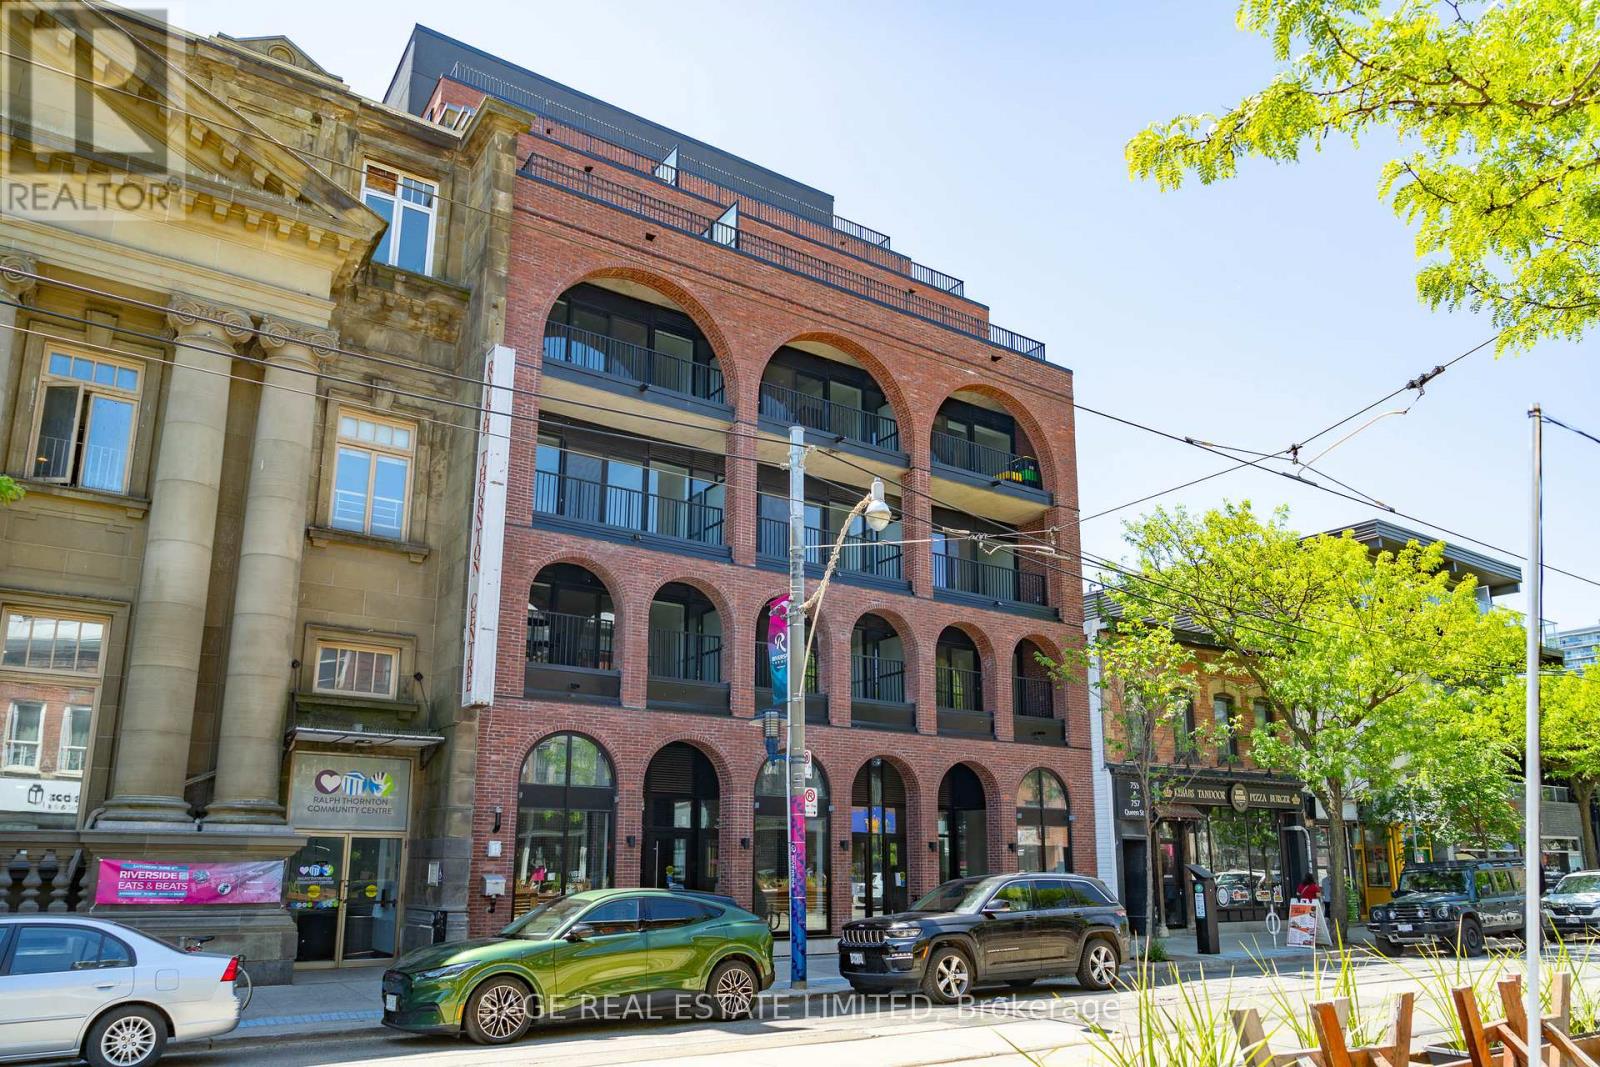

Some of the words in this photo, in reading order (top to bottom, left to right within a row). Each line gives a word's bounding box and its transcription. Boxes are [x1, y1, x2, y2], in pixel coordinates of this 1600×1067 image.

[473, 450, 488, 577] THORNTON
[466, 593, 478, 692] CENTRE
[1197, 789, 1226, 800] TANDOOR
[1249, 793, 1267, 802] PIZZA
[1269, 794, 1291, 804] BURGER
[342, 797, 388, 806] THORNTON
[307, 805, 360, 813] COMMUNITY
[361, 806, 392, 815] CENTRE
[119, 870, 178, 880] RIVERSIDE
[118, 881, 145, 890] EATS
[145, 882, 153, 890] &
[155, 882, 188, 890] BEATS
